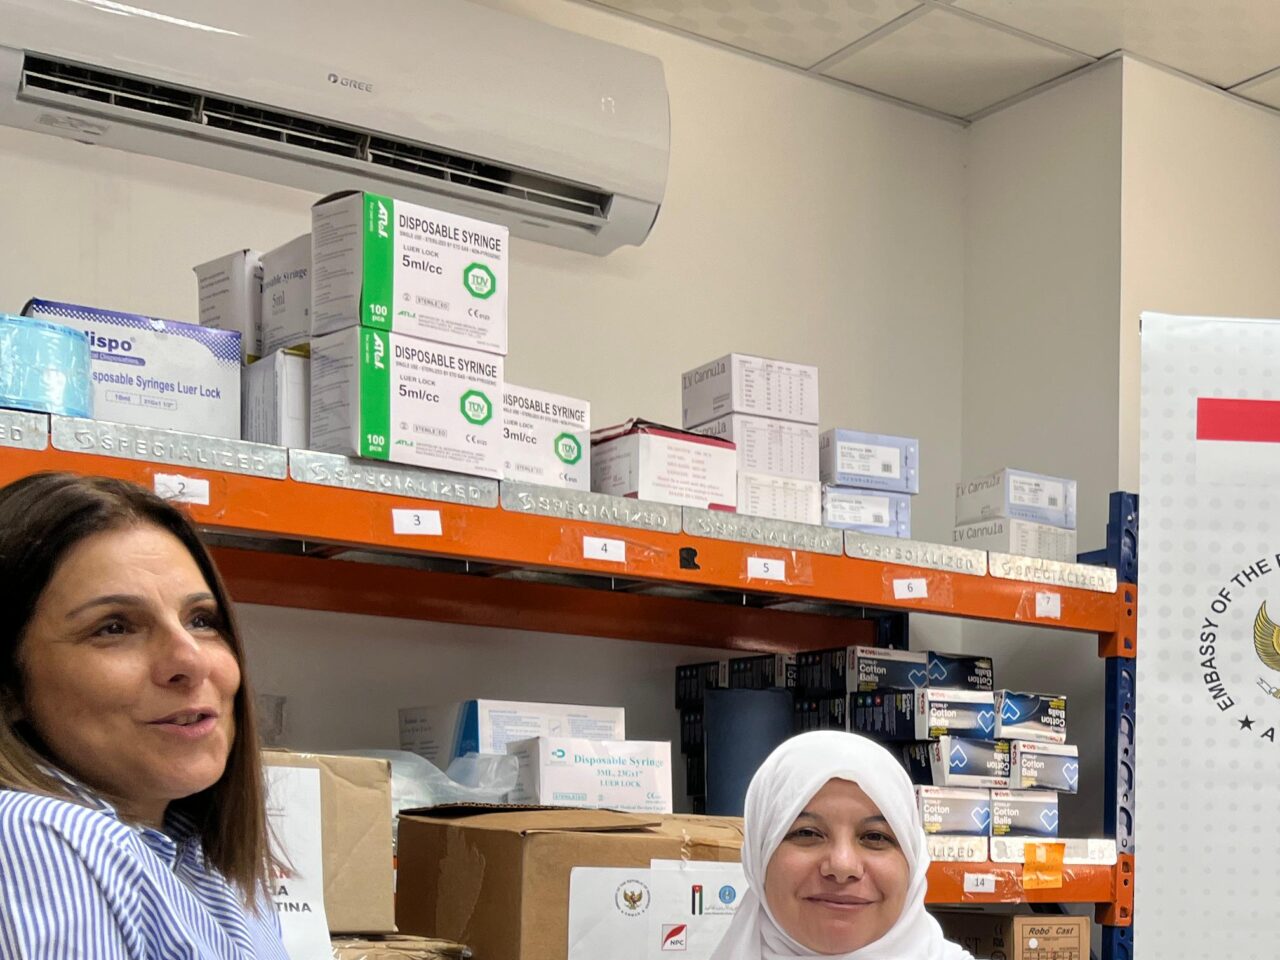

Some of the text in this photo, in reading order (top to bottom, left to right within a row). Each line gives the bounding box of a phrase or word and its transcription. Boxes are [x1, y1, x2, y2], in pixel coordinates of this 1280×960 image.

[340, 77, 373, 93] GREE
[400, 214, 459, 242] DISPOSABLE
[461, 227, 502, 252] SYRINGE
[403, 244, 440, 258] LUER LOCK
[402, 254, 443, 275] 5ml/cc
[369, 303, 388, 316] 100
[395, 344, 456, 370] DISPOSABLE
[457, 357, 498, 379] SYRINGE
[694, 361, 726, 385] Cannula
[136, 374, 221, 400] Syringes Luer Lock
[399, 374, 436, 387] LUER LOCK
[399, 384, 440, 404] 5ml/cc
[551, 404, 586, 423] SYRINGE
[519, 421, 534, 430] LOCK
[366, 433, 385, 446] 100
[503, 427, 537, 445] 3ml/cc
[101, 432, 267, 473] SPECIALIZED
[177, 481, 186, 494] 2
[333, 467, 481, 500] SPECIALIZED
[968, 476, 1001, 495] Cannula
[539, 496, 668, 528] SPECIALIZED
[413, 514, 421, 526] 3
[953, 522, 1003, 542] IV Cannula
[600, 543, 608, 554] 4
[763, 563, 770, 574] 5
[1230, 558, 1272, 589] THE
[907, 583, 914, 594] 6
[1211, 587, 1233, 615] OF
[859, 663, 887, 674] Cotton
[1200, 617, 1235, 712] EMBASSY
[859, 672, 879, 683] Balls
[968, 675, 993, 686] Cotton
[930, 708, 957, 718] Cotton
[930, 716, 949, 726] Balls
[1040, 716, 1066, 727] Cotton
[574, 754, 664, 768] Disposable Syringe
[986, 761, 1010, 771] Cotton
[1021, 758, 1045, 769] Cotton
[1021, 767, 1038, 777] Balls
[621, 780, 641, 788] LOCK
[923, 804, 950, 815] Cotton
[993, 807, 1019, 817] Cotton
[923, 813, 943, 823] Balls
[993, 815, 1012, 825] Balls
[974, 877, 985, 888] 14
[1029, 926, 1074, 935] Robo Cast
